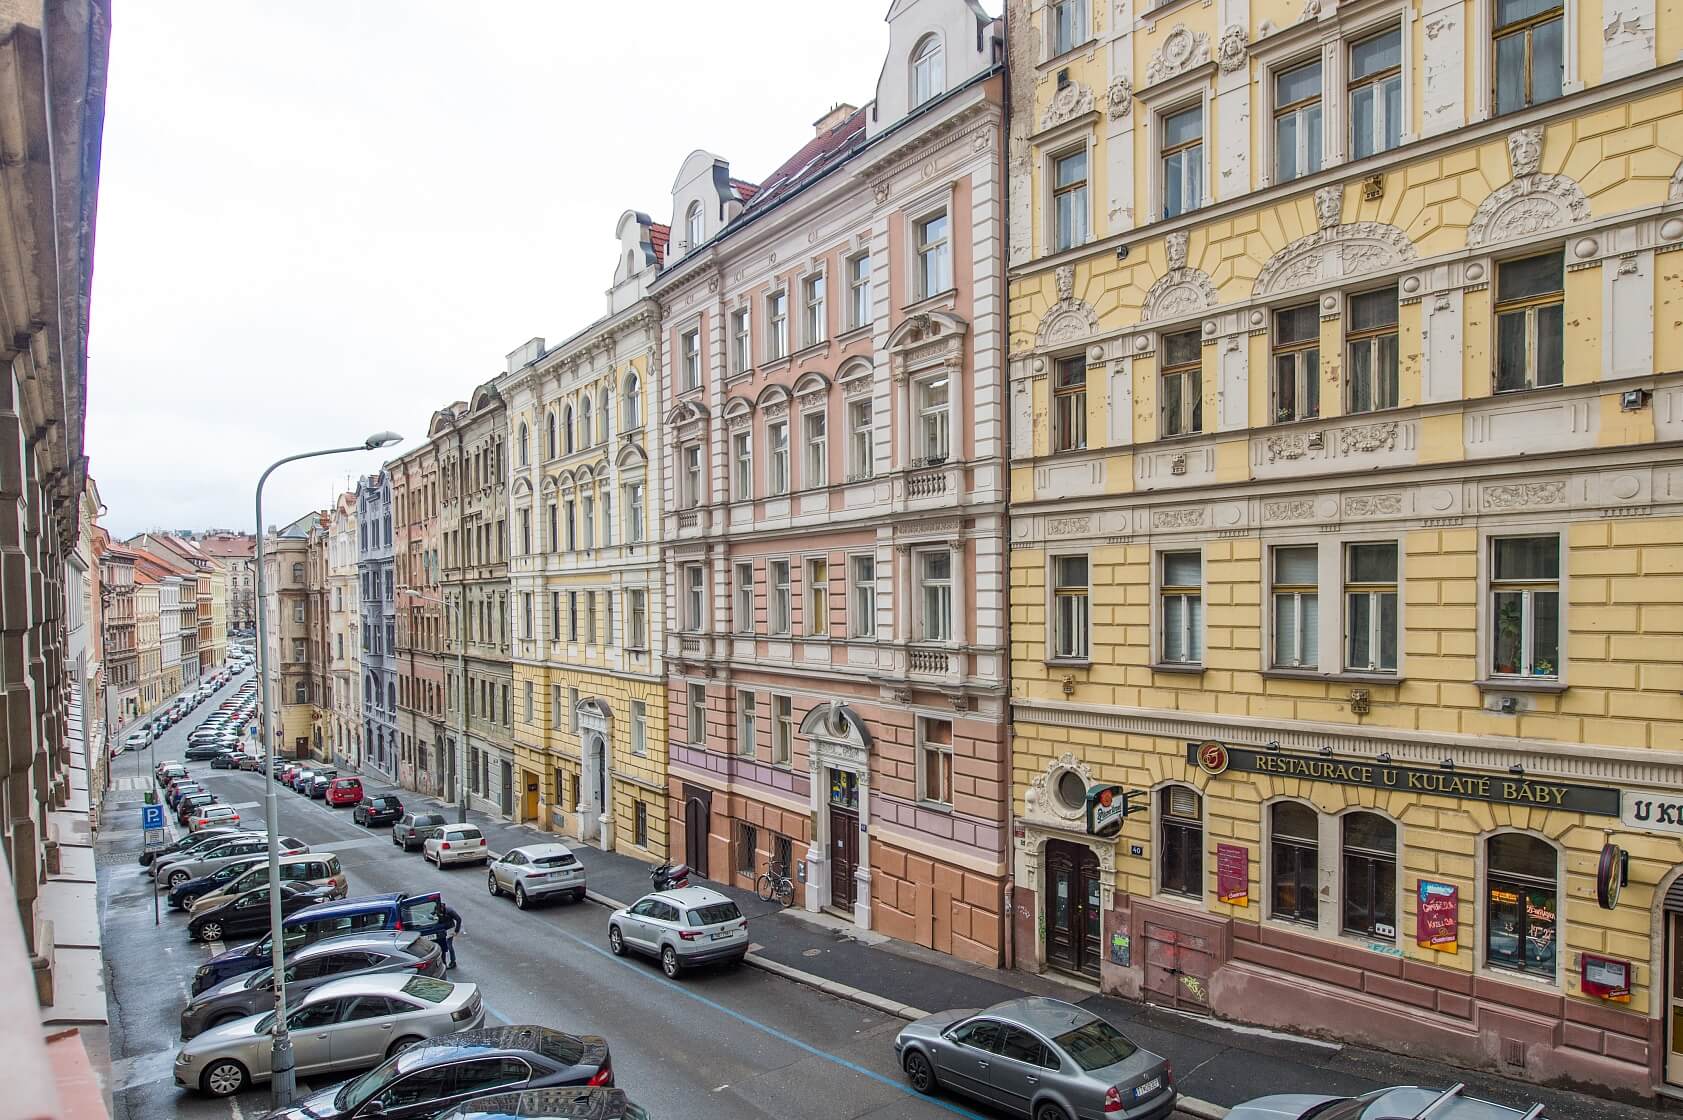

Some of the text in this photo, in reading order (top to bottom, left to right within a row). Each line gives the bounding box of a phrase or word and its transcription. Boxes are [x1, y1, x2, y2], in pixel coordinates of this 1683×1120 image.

[1256, 756, 1569, 805] RESTAURACE U KULATÉ BÁBY
[147, 808, 158, 822] P
[1634, 800, 1653, 821] U
[1132, 846, 1141, 855] 40
